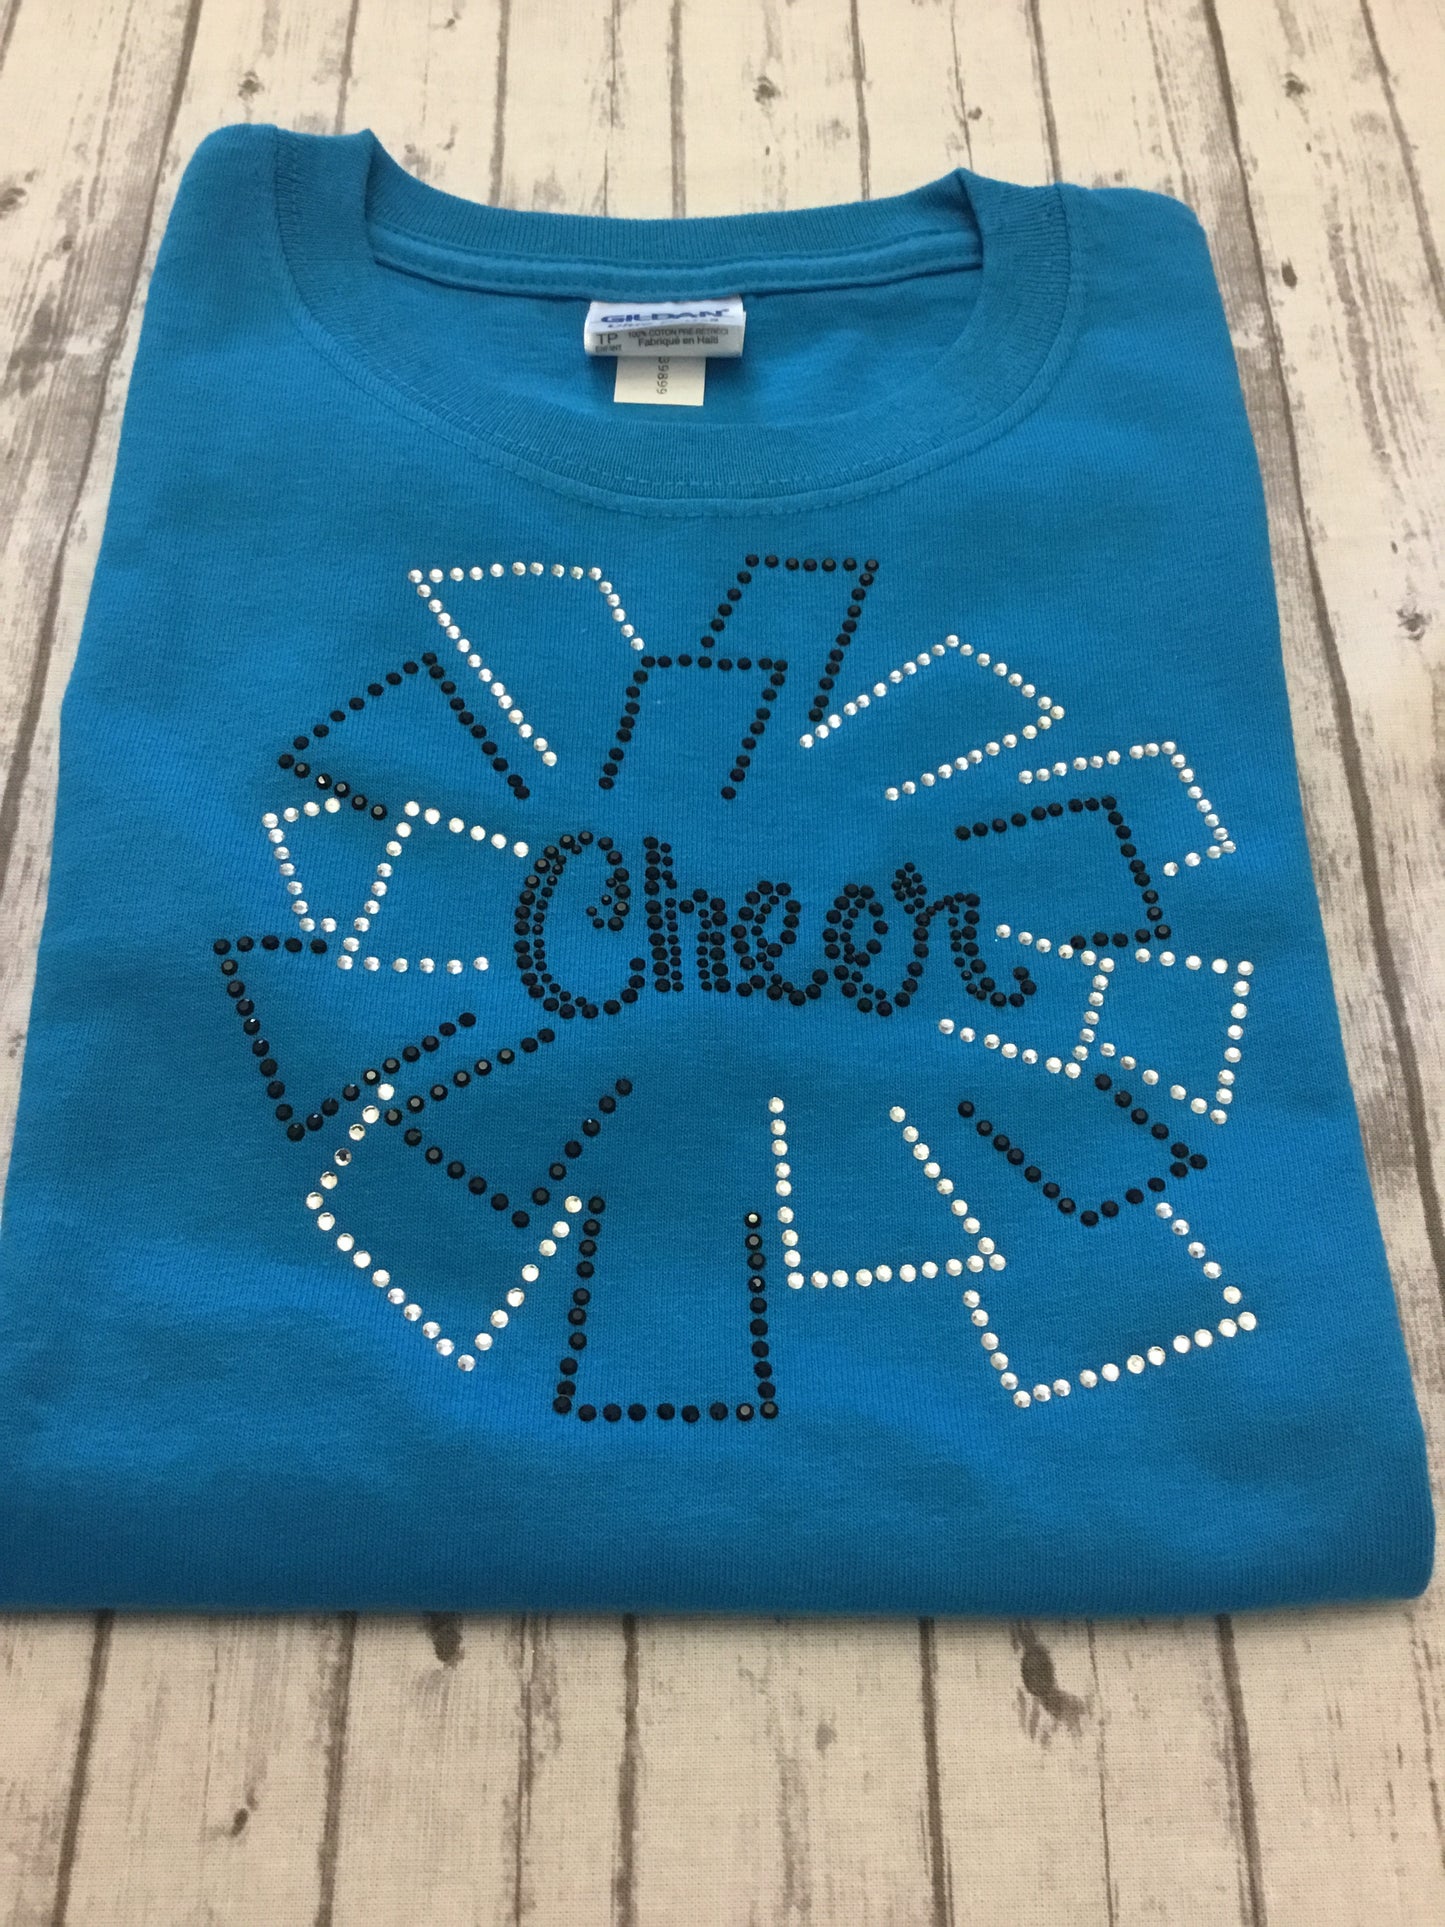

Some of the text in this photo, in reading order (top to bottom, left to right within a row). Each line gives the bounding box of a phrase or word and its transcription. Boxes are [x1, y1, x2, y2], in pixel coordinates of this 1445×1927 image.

[600, 309, 724, 323] GILDAN
[596, 332, 618, 345] TP
[648, 328, 677, 337] COTON
[682, 337, 695, 345] en
[514, 831, 1037, 1017] Cheer
